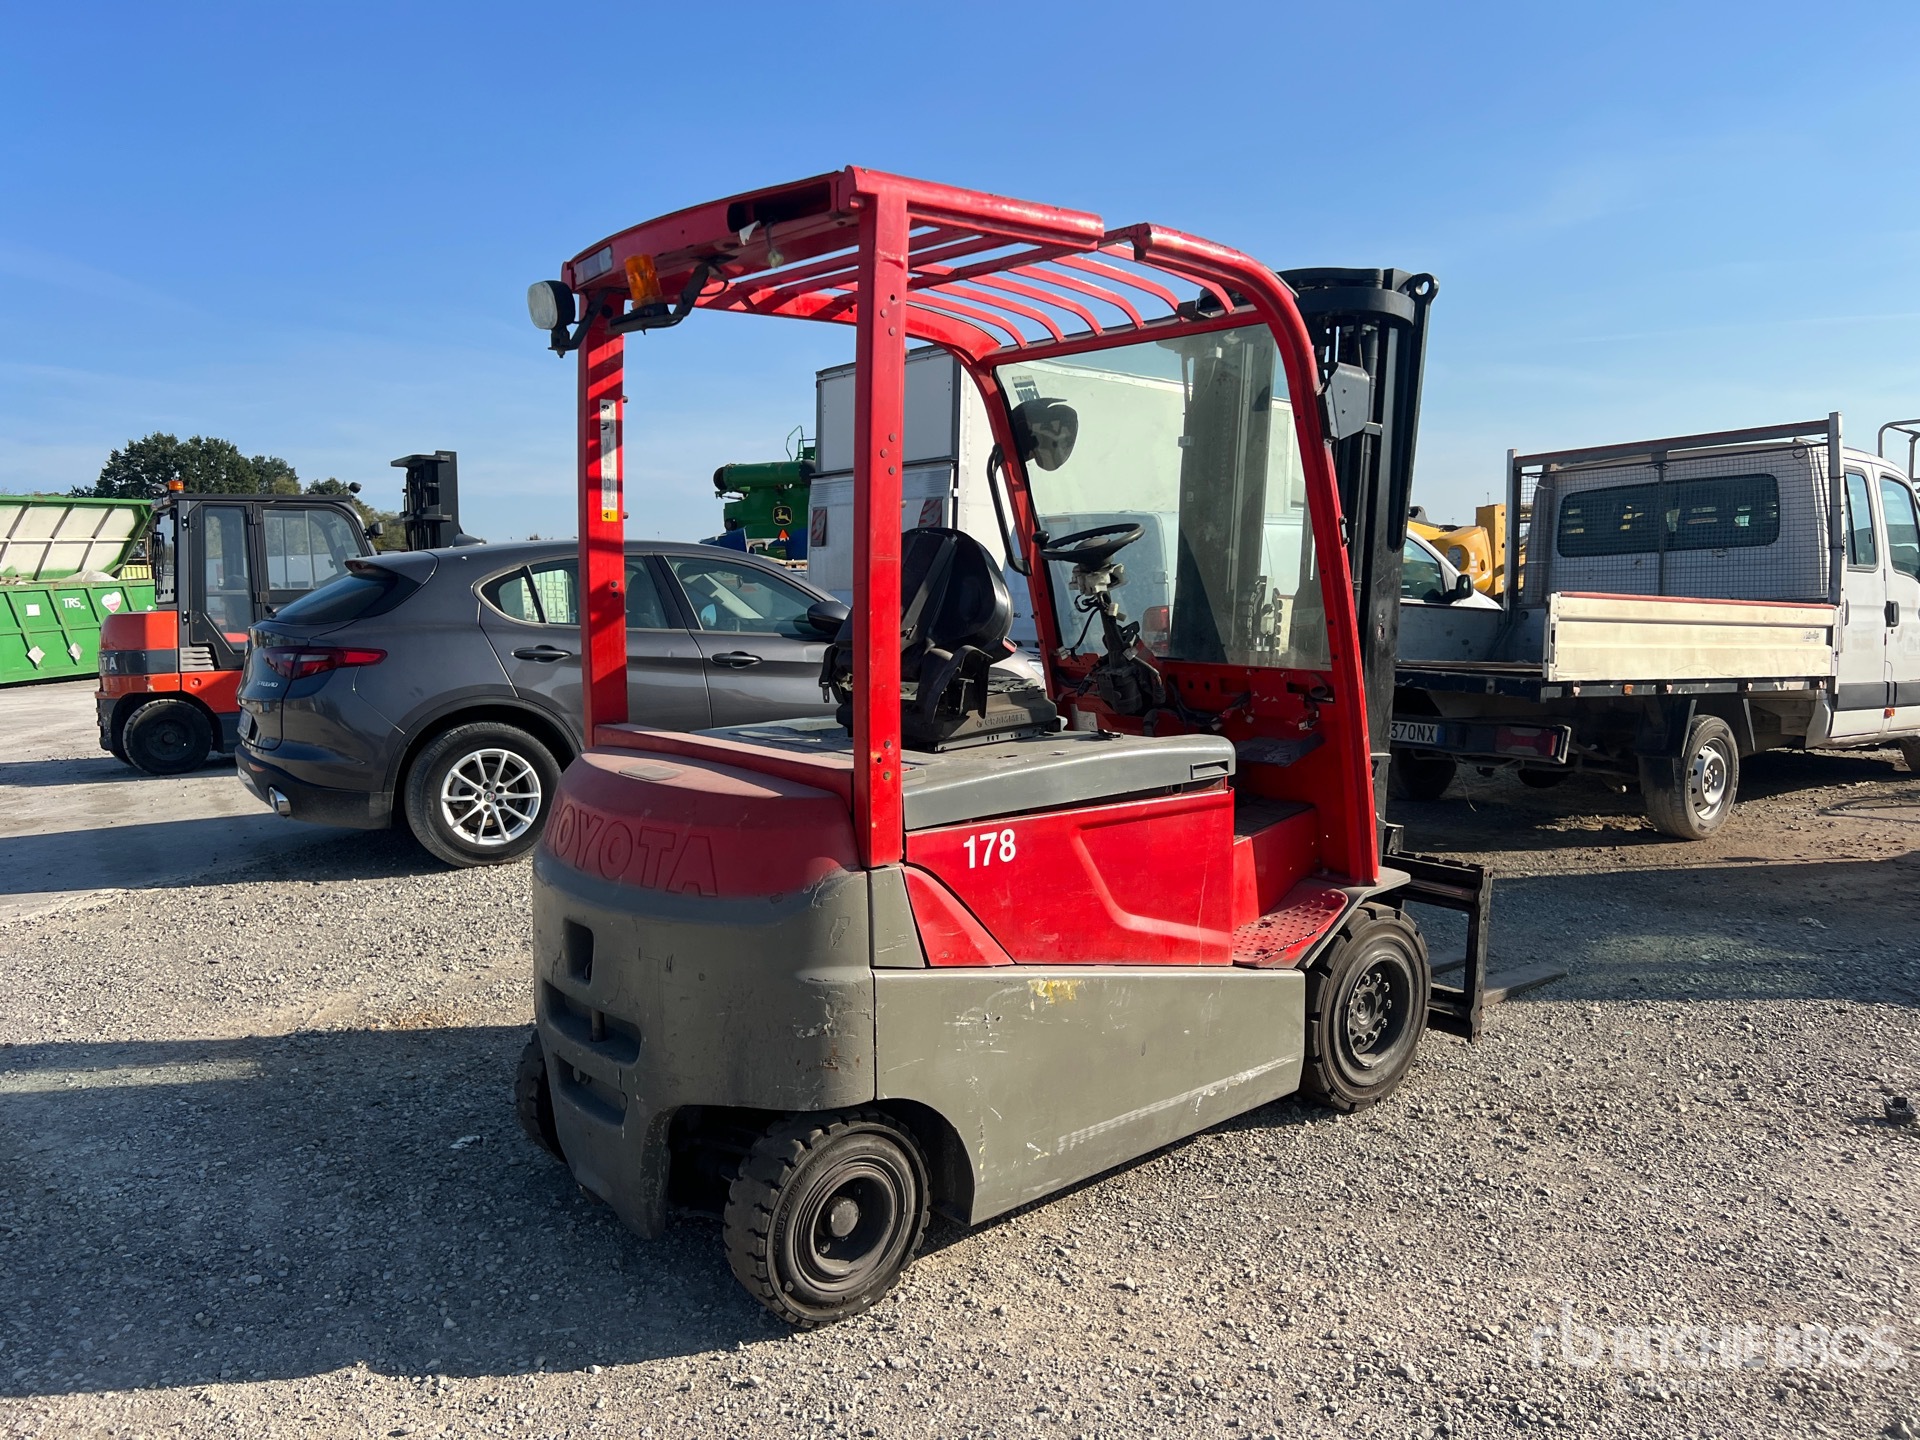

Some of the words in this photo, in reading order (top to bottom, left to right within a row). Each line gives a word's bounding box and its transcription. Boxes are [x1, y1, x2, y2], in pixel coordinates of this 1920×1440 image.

[62, 597, 81, 609] TRS
[99, 656, 118, 672] TA
[963, 828, 1017, 869] 178
